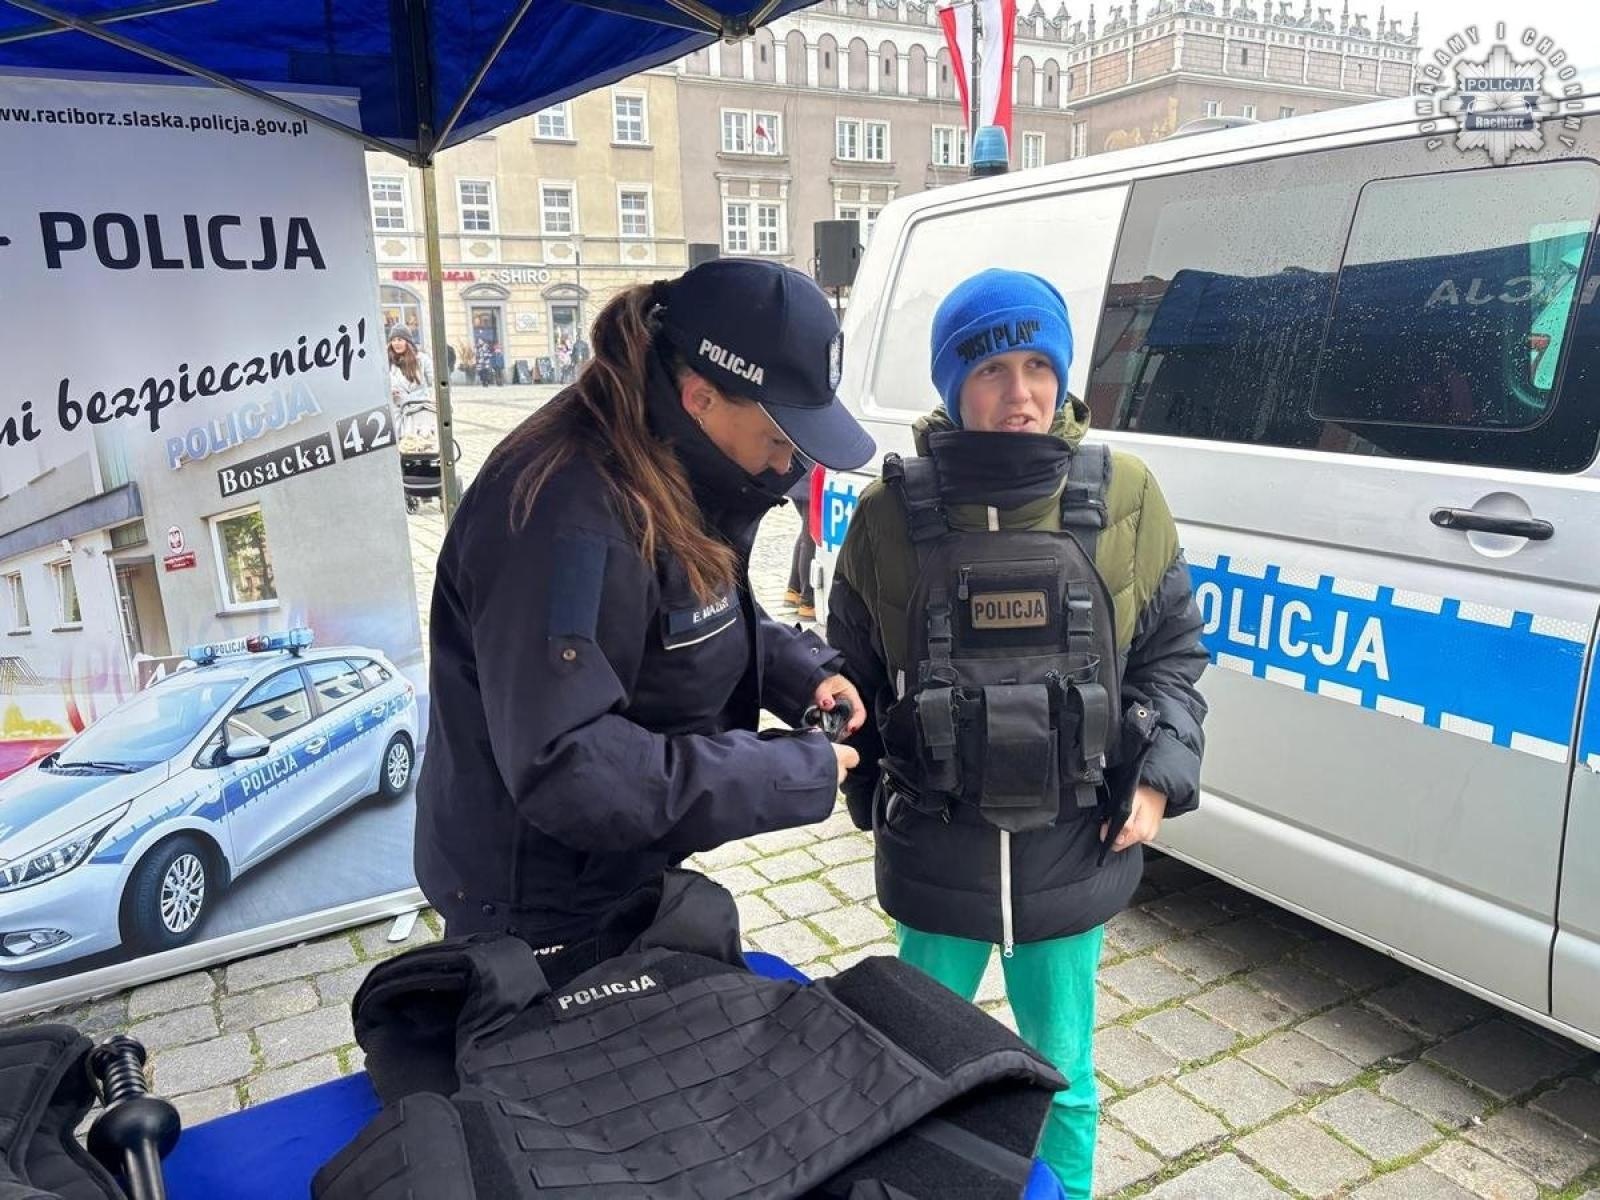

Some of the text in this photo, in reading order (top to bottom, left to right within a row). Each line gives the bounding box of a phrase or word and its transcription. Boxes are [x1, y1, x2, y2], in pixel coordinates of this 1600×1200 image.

[39, 211, 327, 270] POLICJA
[500, 270, 551, 284] SHIRO
[58, 317, 367, 432] bezpieczniej!
[699, 338, 765, 385] POLICJA
[167, 384, 322, 470] POLICJA
[221, 411, 392, 495] Bosacka 42
[974, 596, 1045, 621] POLICJA
[1195, 582, 1391, 682] OLICJA
[214, 640, 246, 654] POLICJA
[240, 754, 298, 797] POLICJA
[557, 974, 657, 1010] POLICJA
